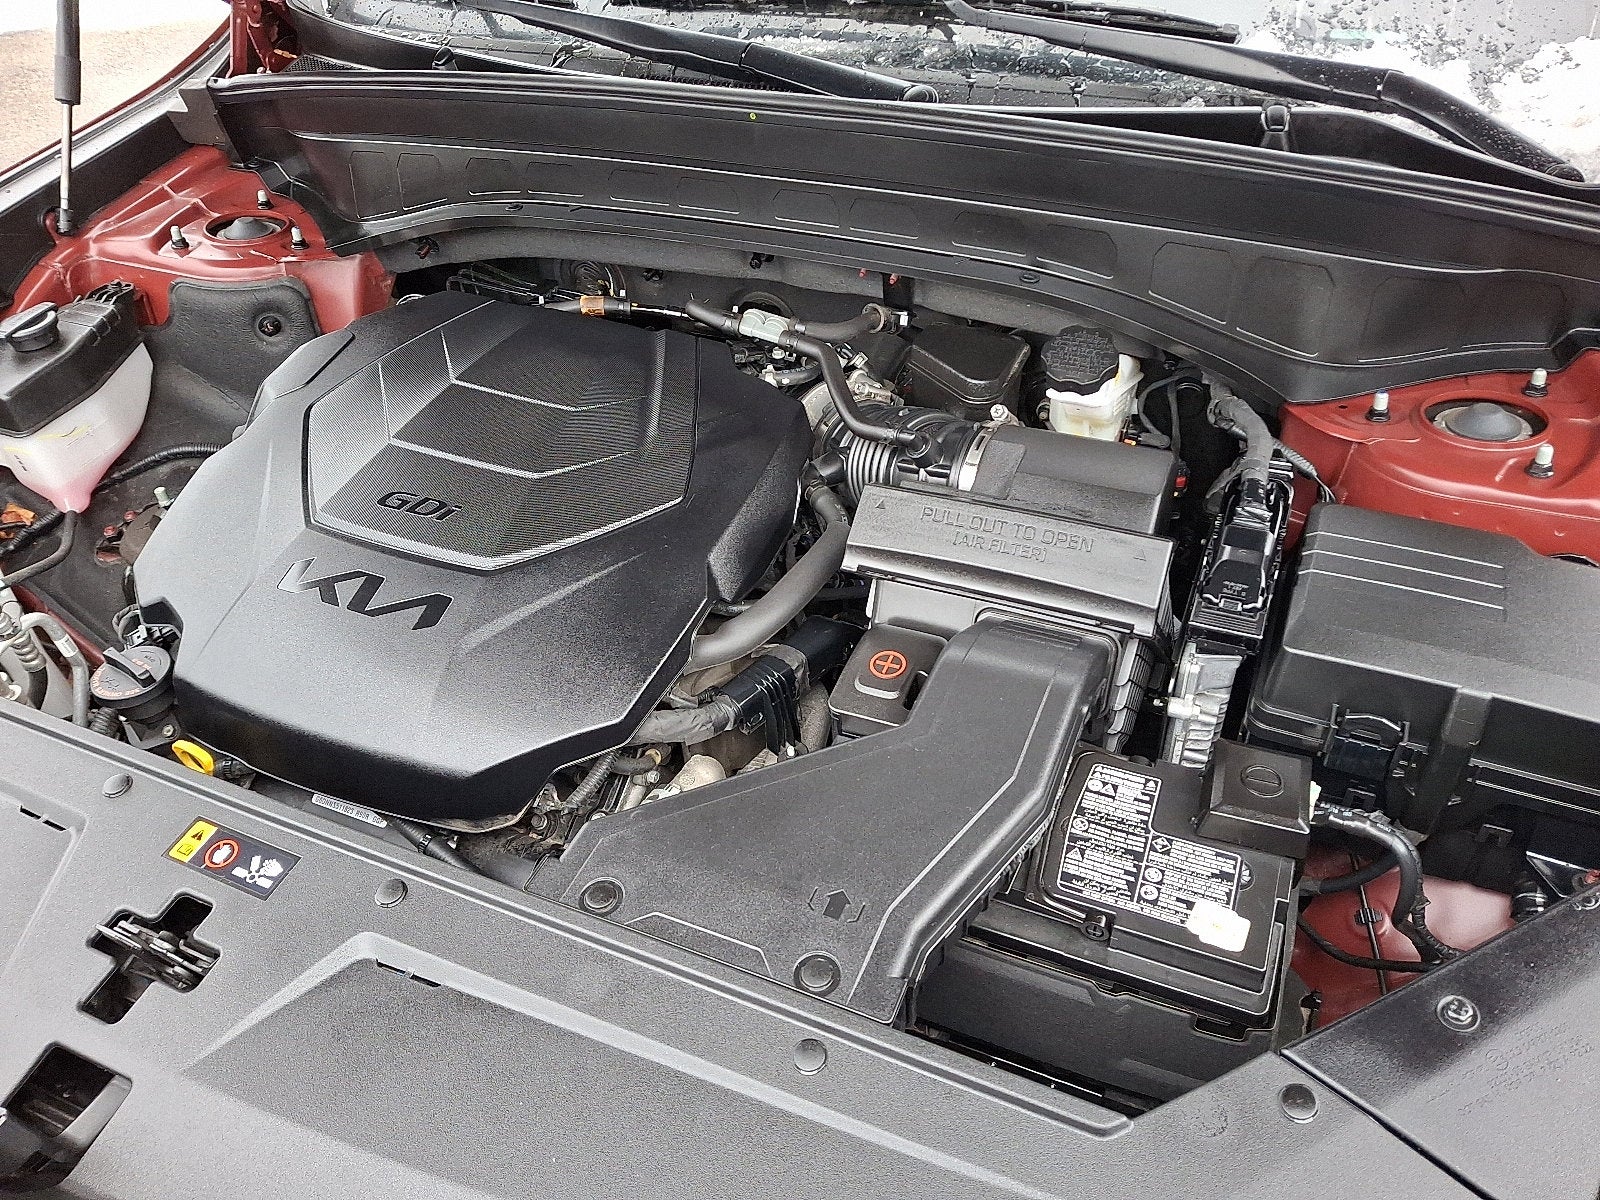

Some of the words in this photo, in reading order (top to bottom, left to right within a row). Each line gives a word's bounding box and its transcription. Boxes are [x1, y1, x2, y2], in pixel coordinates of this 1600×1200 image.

[377, 491, 462, 521] GDi
[920, 505, 964, 527] PULL
[969, 515, 1009, 535] OUT
[1013, 522, 1037, 541] TO
[1040, 528, 1095, 552] OPEN
[277, 557, 454, 630] KIA
